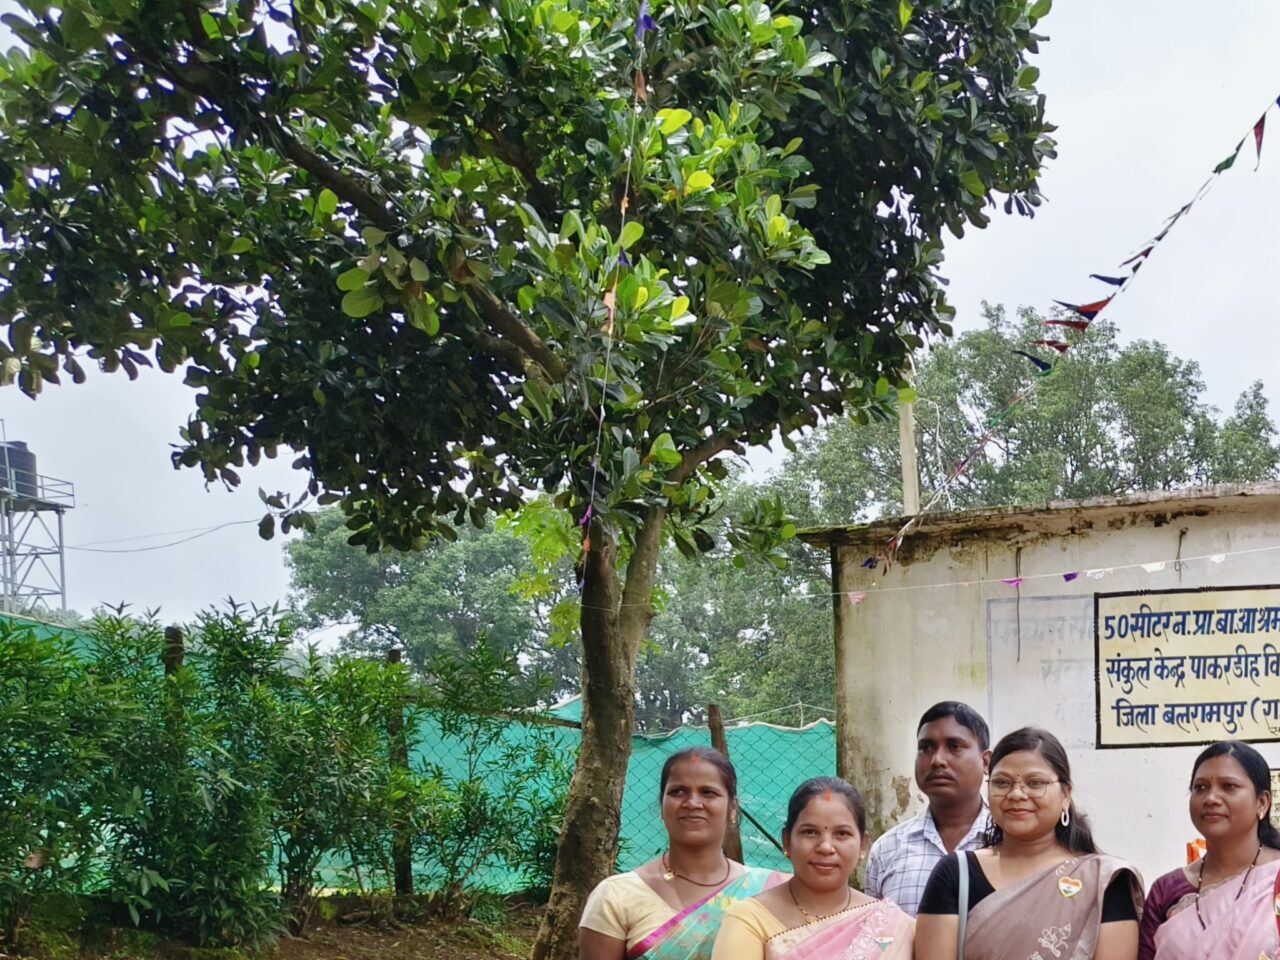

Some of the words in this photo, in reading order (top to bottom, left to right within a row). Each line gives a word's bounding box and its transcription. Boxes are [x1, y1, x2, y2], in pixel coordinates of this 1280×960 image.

[1106, 652, 1153, 694] संकुल
[1154, 648, 1187, 689] केन्द्र
[1189, 644, 1261, 687] पाकरडीह
[1111, 698, 1159, 733] जिला
[1163, 701, 1247, 734] बलरामपुर
